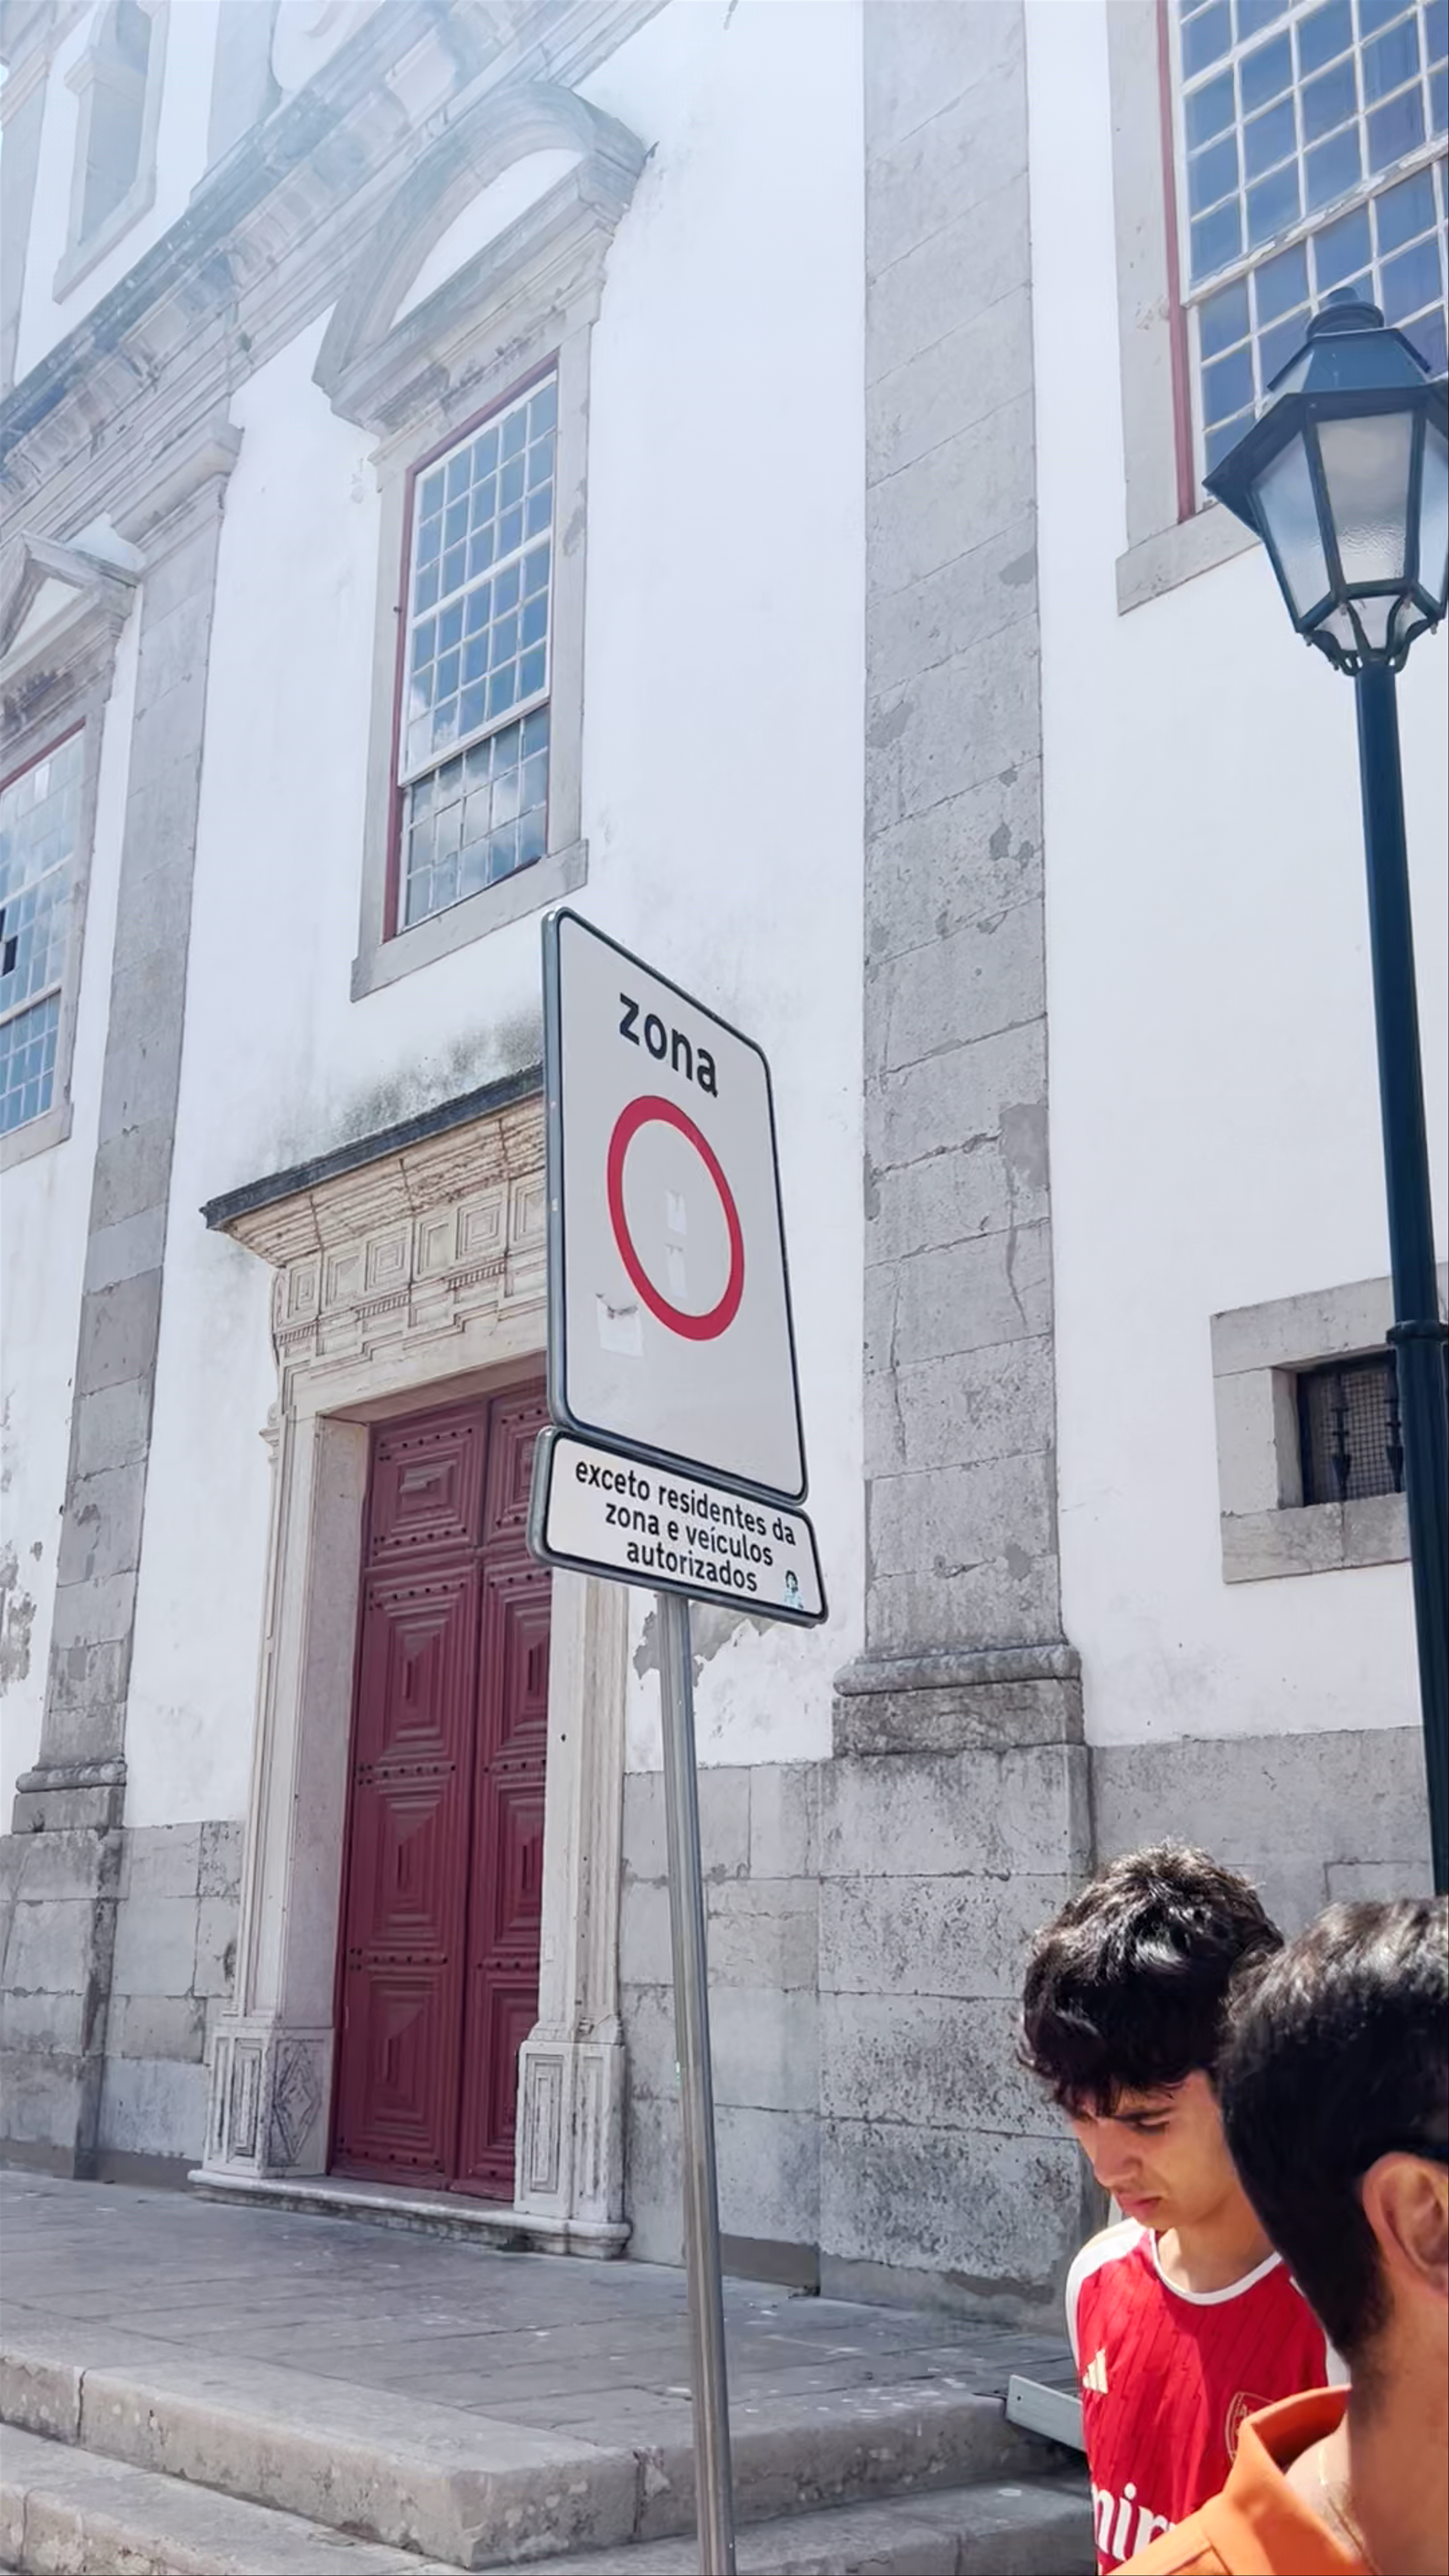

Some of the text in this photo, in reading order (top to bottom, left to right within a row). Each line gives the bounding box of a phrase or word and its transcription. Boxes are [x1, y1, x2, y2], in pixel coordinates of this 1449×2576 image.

[619, 992, 718, 1098] zona
[575, 1461, 796, 1546] exceto residentes da
[605, 1503, 773, 1566] zona e veículos
[626, 1541, 758, 1592] autorizados
